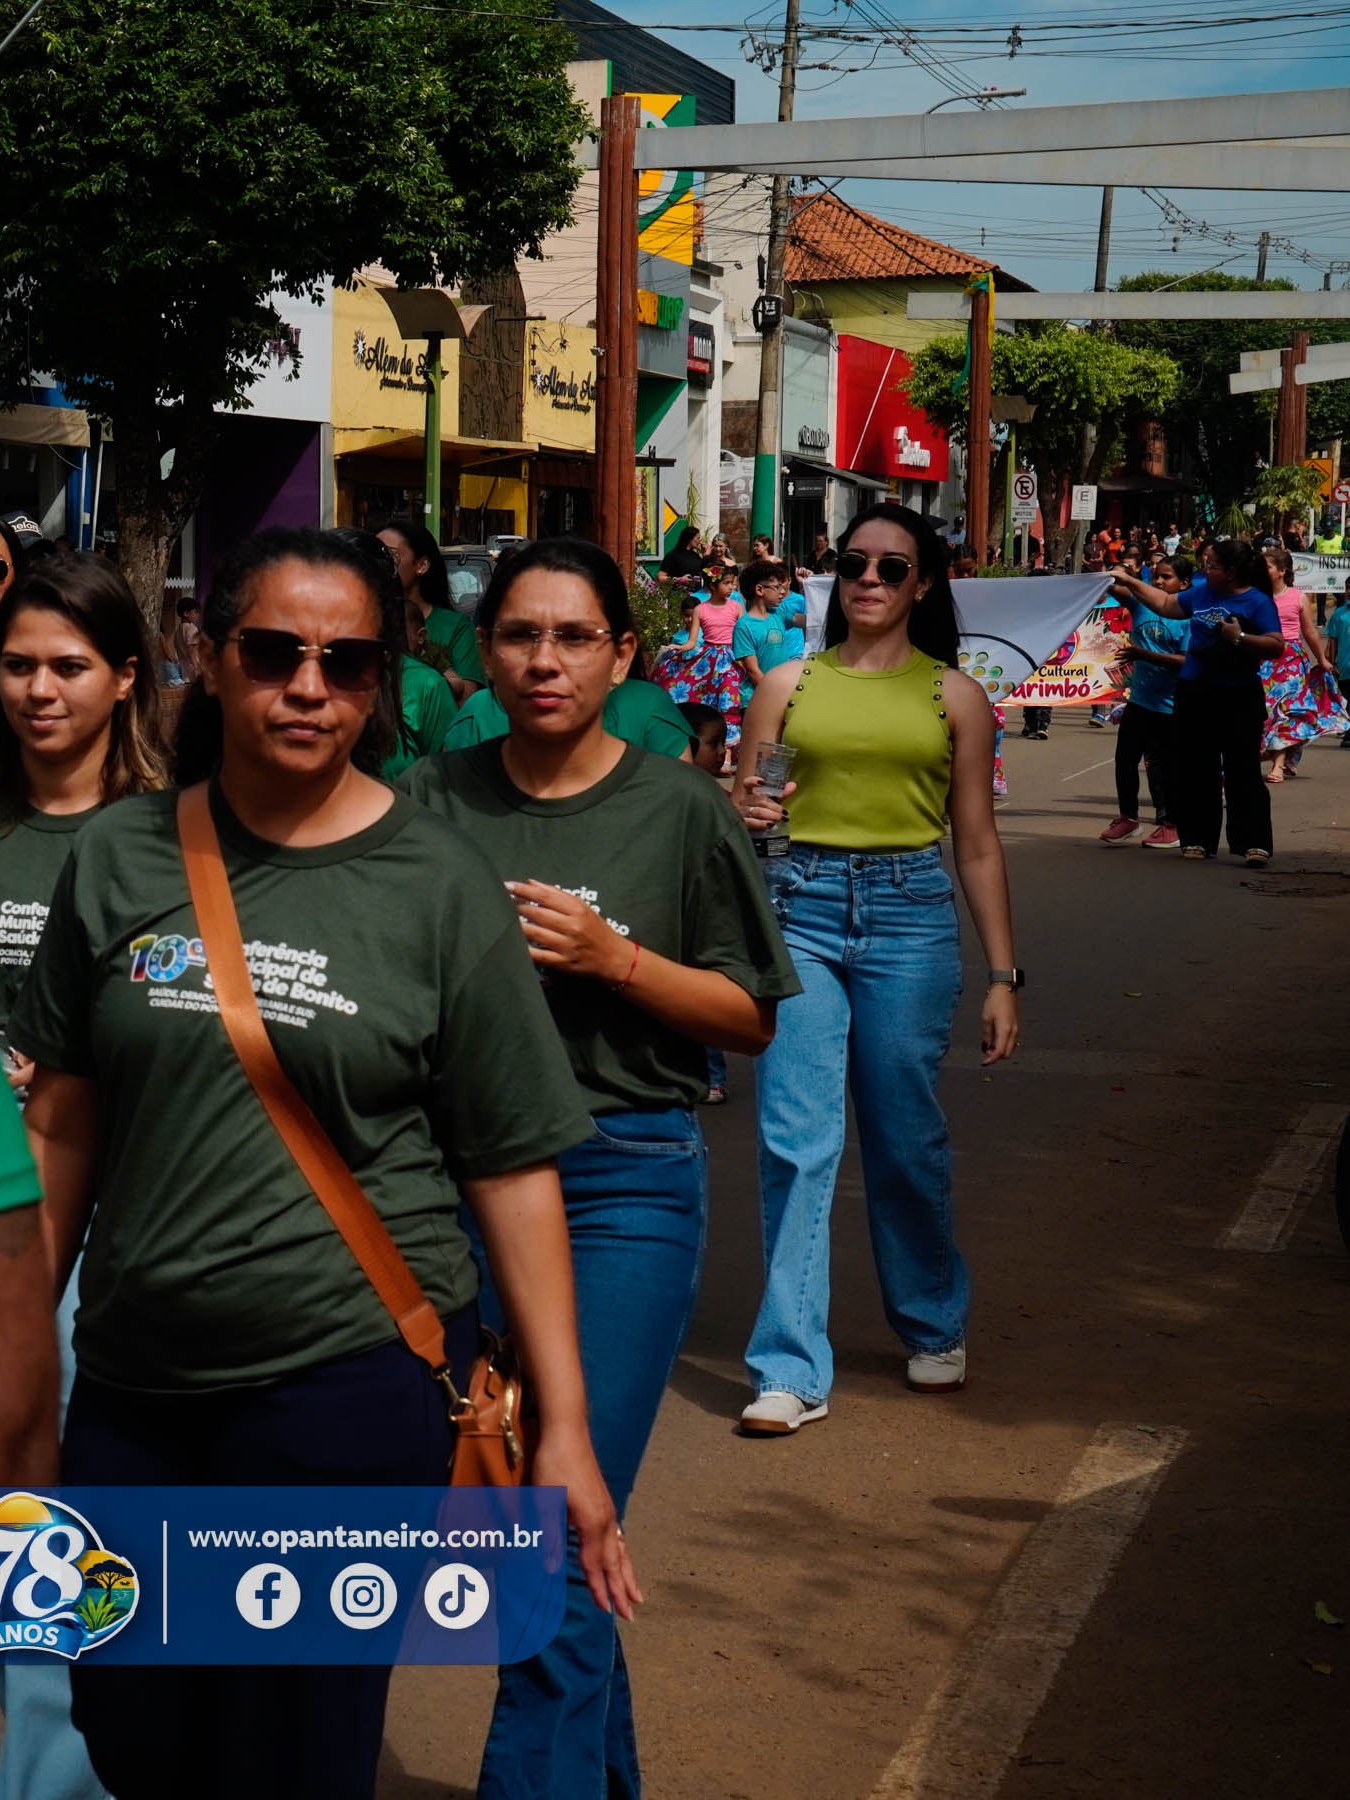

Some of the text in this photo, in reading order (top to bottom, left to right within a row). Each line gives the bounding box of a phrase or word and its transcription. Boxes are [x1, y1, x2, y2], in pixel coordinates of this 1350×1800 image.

[1038, 665, 1088, 678] Cultural
[1011, 677, 1091, 699] arimbó
[299, 967, 328, 987] de
[263, 978, 289, 996] de
[290, 983, 359, 1016] Bonito
